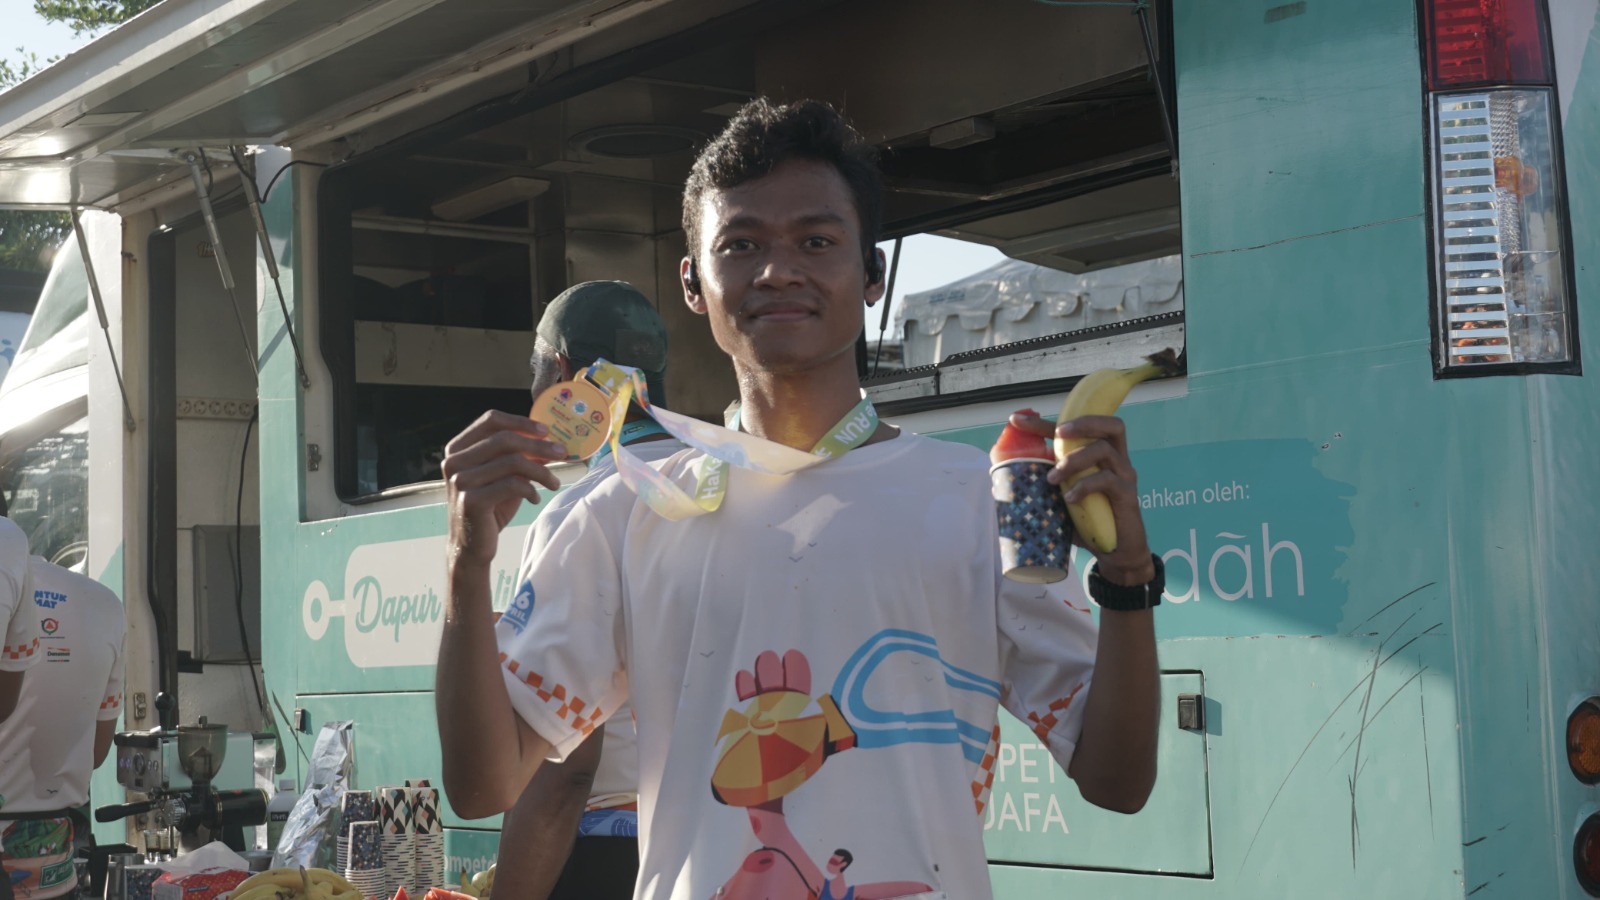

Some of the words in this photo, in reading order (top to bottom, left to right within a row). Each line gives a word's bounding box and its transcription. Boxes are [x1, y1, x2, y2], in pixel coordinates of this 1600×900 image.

[834, 411, 871, 445] RUN
[1202, 480, 1250, 503] oleh:
[34, 590, 68, 602] NTUK
[352, 575, 442, 643] Dapur
[993, 743, 1055, 784] PET
